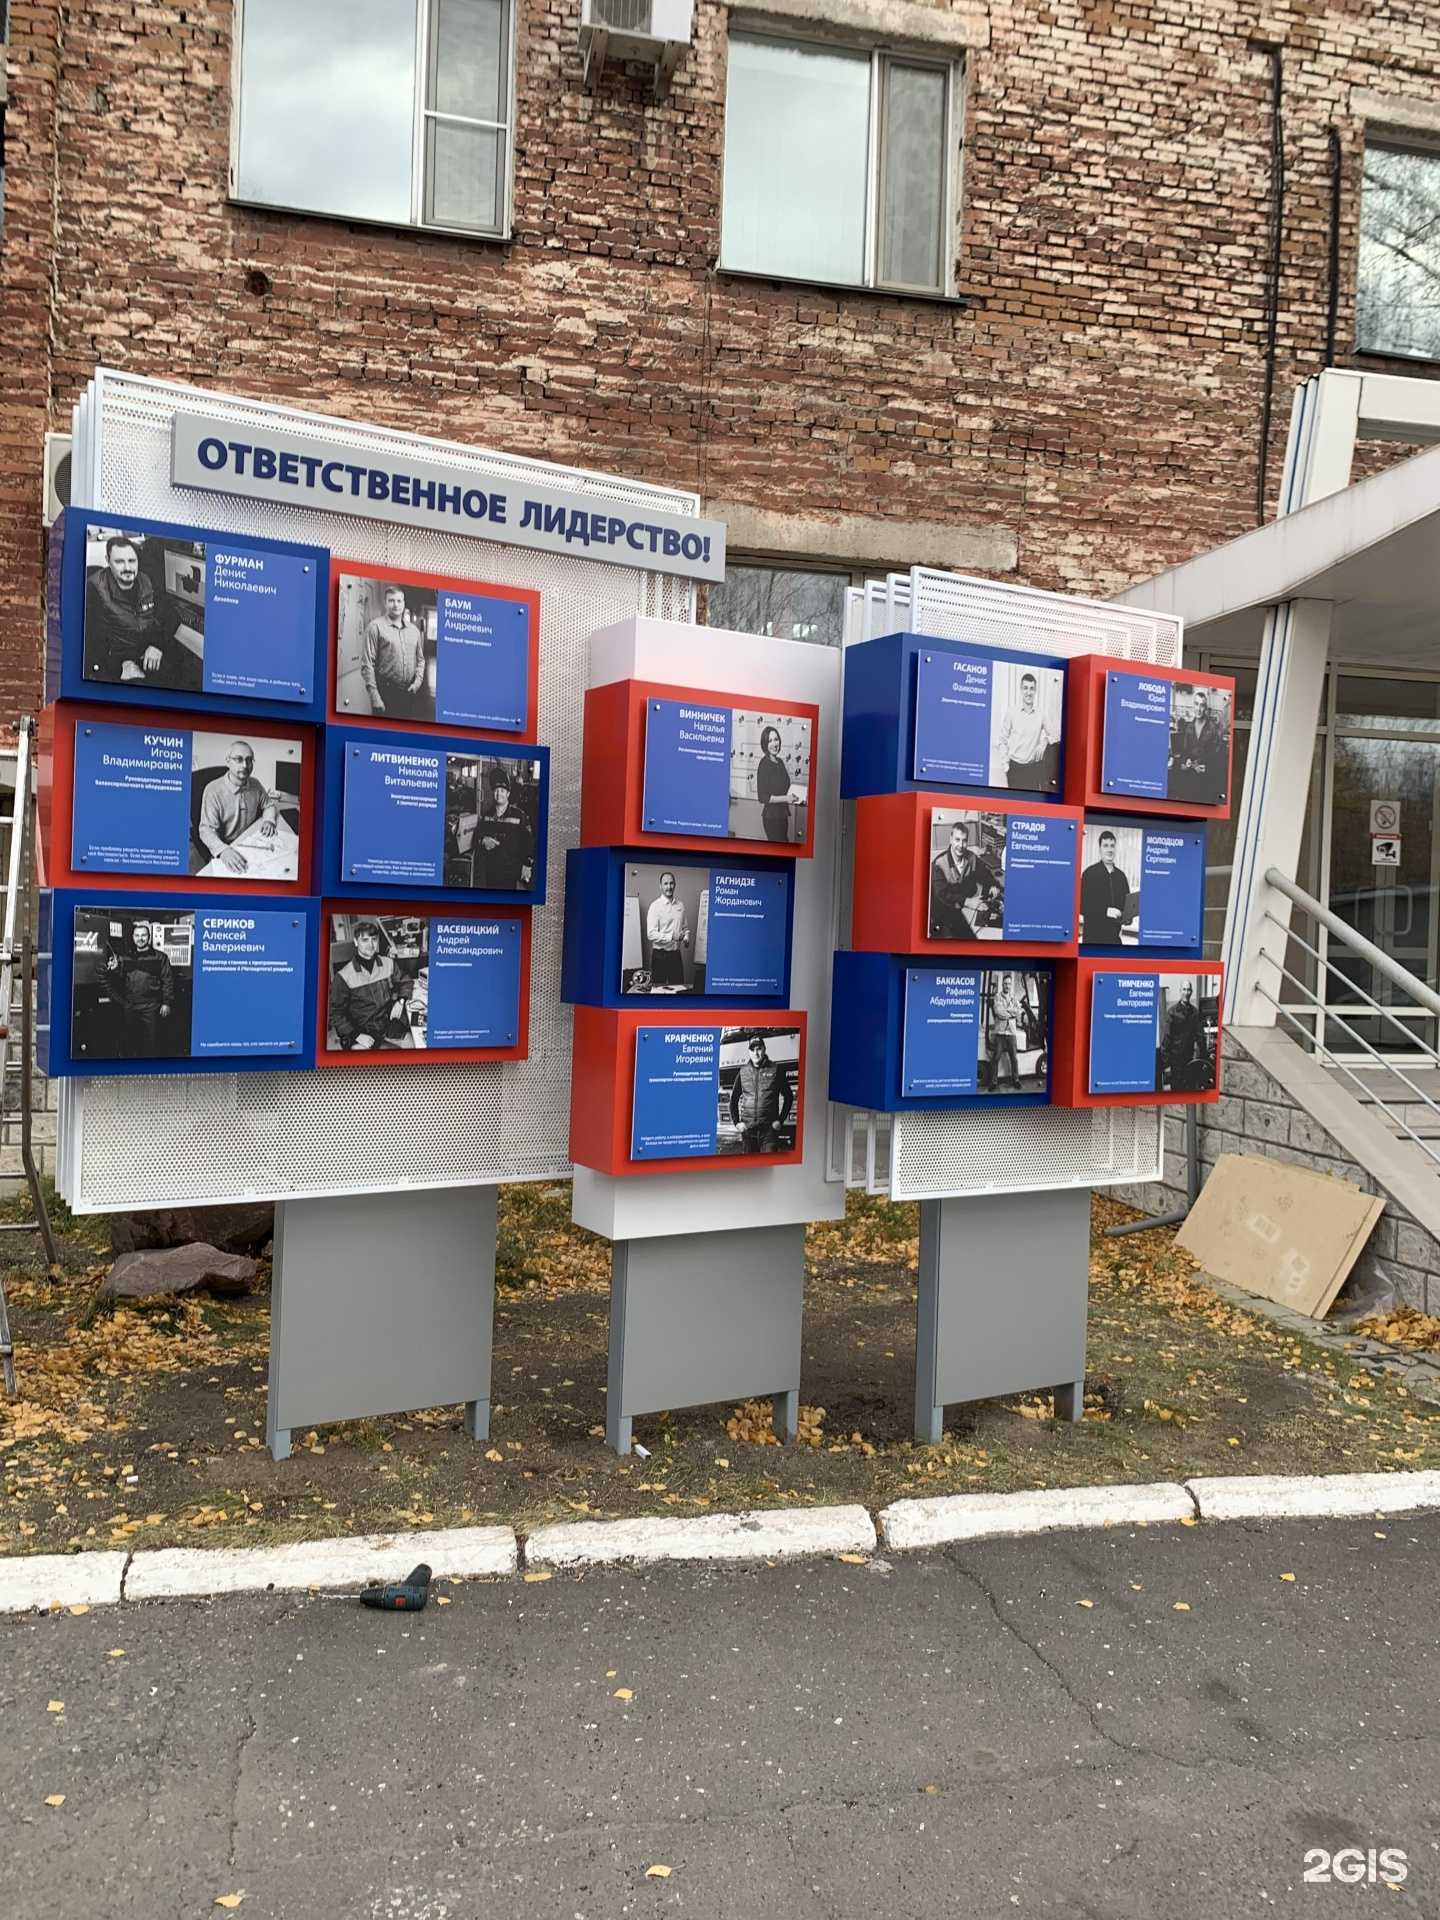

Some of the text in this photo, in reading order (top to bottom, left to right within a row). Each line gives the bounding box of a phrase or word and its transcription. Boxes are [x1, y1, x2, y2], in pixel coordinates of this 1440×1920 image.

[197, 438, 711, 563] ОТВЕТСТВЕННОЕ ЛИДЕРСТВО!
[214, 553, 264, 571] ФУРМАН
[214, 565, 247, 579] Денис
[214, 576, 277, 595] Николаевич
[444, 597, 472, 611] БАУМ
[444, 608, 482, 623] Николай
[444, 618, 493, 634] Андреевич
[953, 661, 988, 675] ГАСАНОВ
[965, 673, 988, 685] Денис
[1138, 682, 1166, 695] ЛОБОДА
[679, 709, 726, 723] ВИННИЧЕК
[693, 720, 725, 734] Наталья
[143, 734, 184, 748] КУЧИН
[679, 729, 725, 744] Васильевна
[150, 747, 184, 760] Игорь
[370, 751, 439, 768] ЛИТВИНЕНКО
[102, 754, 183, 771] Владимирович
[398, 765, 439, 779] Николай
[384, 775, 438, 790] Витальевич
[1011, 821, 1046, 832] СТРАДОВ
[1011, 831, 1039, 841] Максим
[1146, 836, 1184, 847] МОЛОДЦОВ
[1011, 841, 1050, 853] Евгеньевич
[715, 876, 757, 888] ГАГНИДЗЕ
[715, 885, 739, 895] Роман
[714, 895, 762, 906] Жорданович
[203, 918, 255, 929] СЕРИКОВ
[202, 929, 247, 941] Алексей
[437, 924, 500, 936] ВАСЕВИЦКИЙ
[436, 934, 470, 946] Андрей
[202, 941, 265, 954] Валериевич
[436, 945, 504, 957] Александрович
[936, 976, 976, 986] БАККАСОВ
[1118, 979, 1155, 989] ТИМЧЕНКО
[1129, 989, 1154, 998] Евгений
[1117, 998, 1154, 1009] Викторович
[664, 1033, 715, 1043] КРАВЧЕНКО
[682, 1044, 714, 1053] Евгений
[675, 1055, 713, 1065] Игоревич
